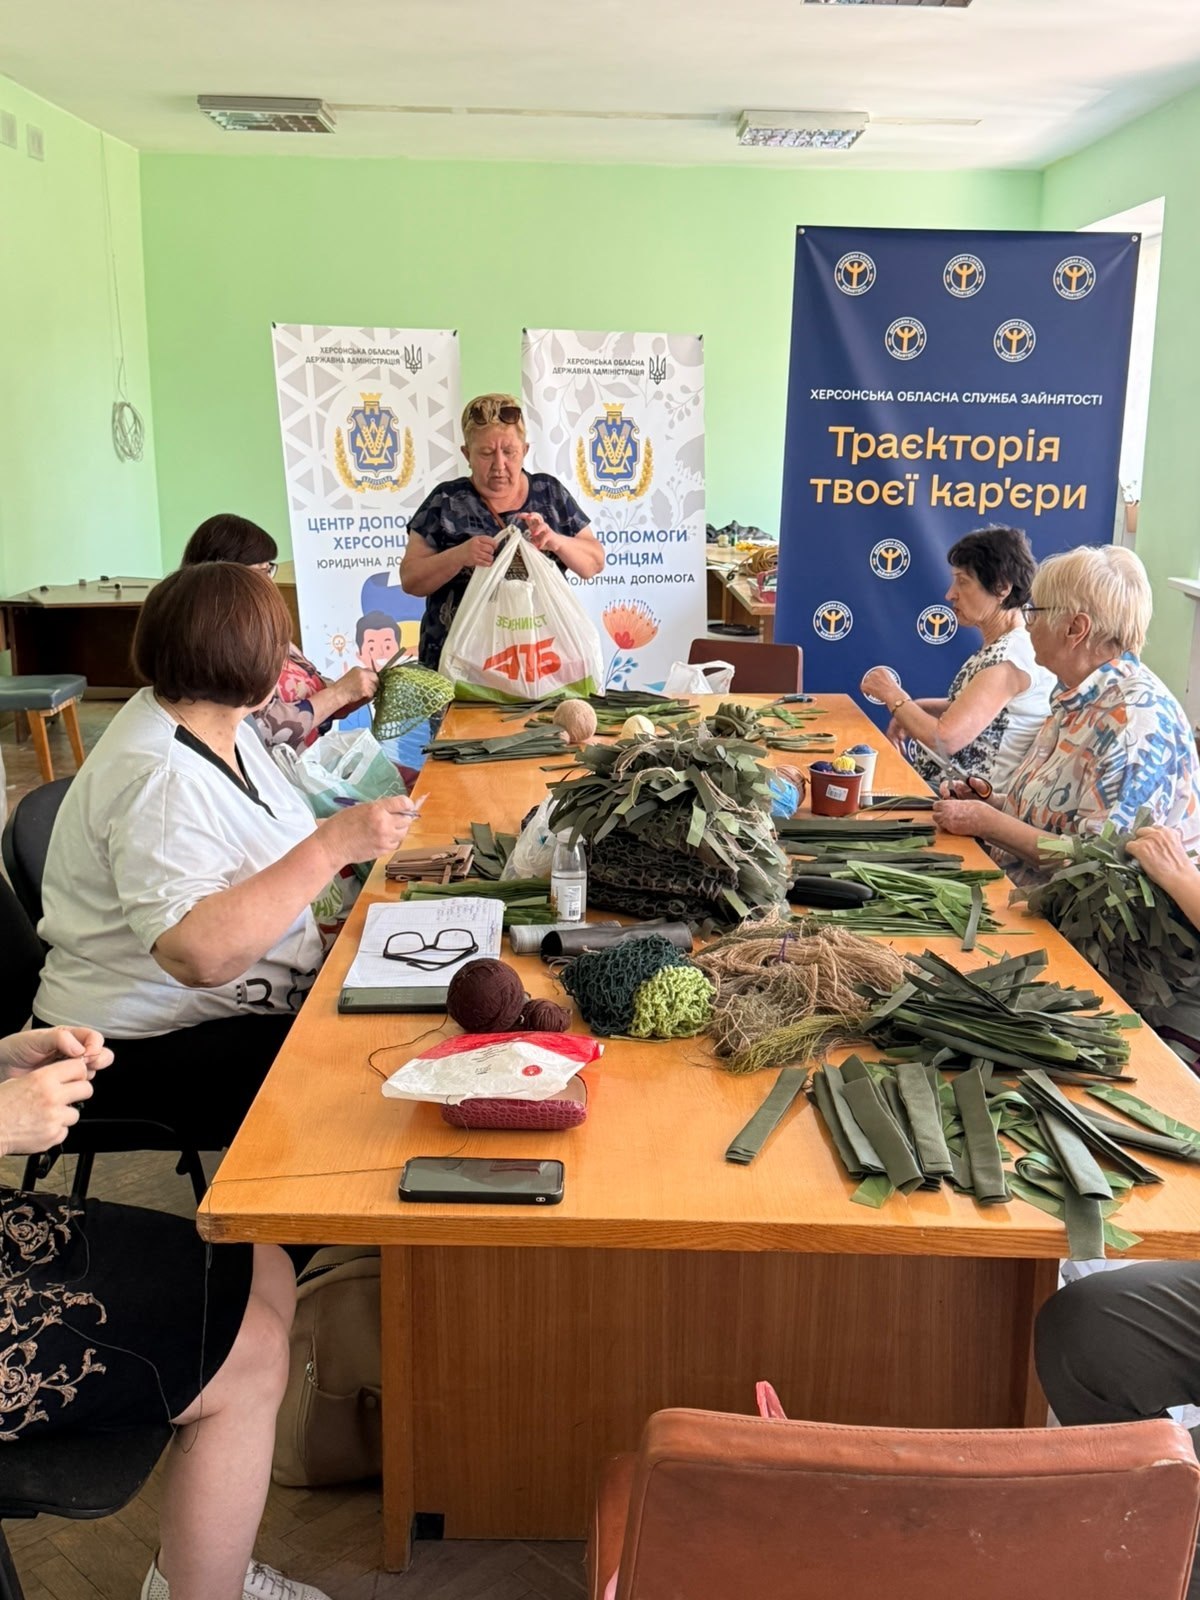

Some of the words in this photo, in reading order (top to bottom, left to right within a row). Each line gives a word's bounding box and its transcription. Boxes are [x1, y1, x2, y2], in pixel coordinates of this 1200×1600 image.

[320, 347, 366, 355] ХЕРСОНСЬКА
[368, 348, 400, 356] ОБЛАСНА
[305, 356, 345, 364] ДЕРЖАВНА
[347, 357, 401, 365] АДМІНІСТРАЦІЯ
[567, 358, 612, 366] ХЕРСОНСЬКА
[552, 367, 591, 375] ДЕРЖАВНА
[592, 367, 645, 376] АДМІНІСТРАЦІЯ
[810, 389, 894, 401] ХЕРСОНСЬКА
[897, 391, 959, 403] ОБЛАСНА
[962, 392, 1018, 404] СЛУЖБА
[1021, 392, 1103, 405] ЗАЙНЯТОСТІ
[828, 426, 1060, 469] Траєкторія
[809, 473, 919, 506] твоєї
[930, 474, 1087, 516] кар'єри
[307, 517, 355, 533] ЦЕНТР
[359, 515, 412, 532] ДОПО
[333, 535, 406, 550] ХЕРСОНЦ
[596, 529, 688, 545] ДОПОМОГИ
[317, 557, 382, 570] ЮРИДИЧНА
[606, 552, 664, 567] ОНЦЯМ
[567, 575, 626, 586] ОЛОГІЧНА
[630, 573, 695, 585] ДОПОМОГА
[482, 636, 561, 683] АТБ
